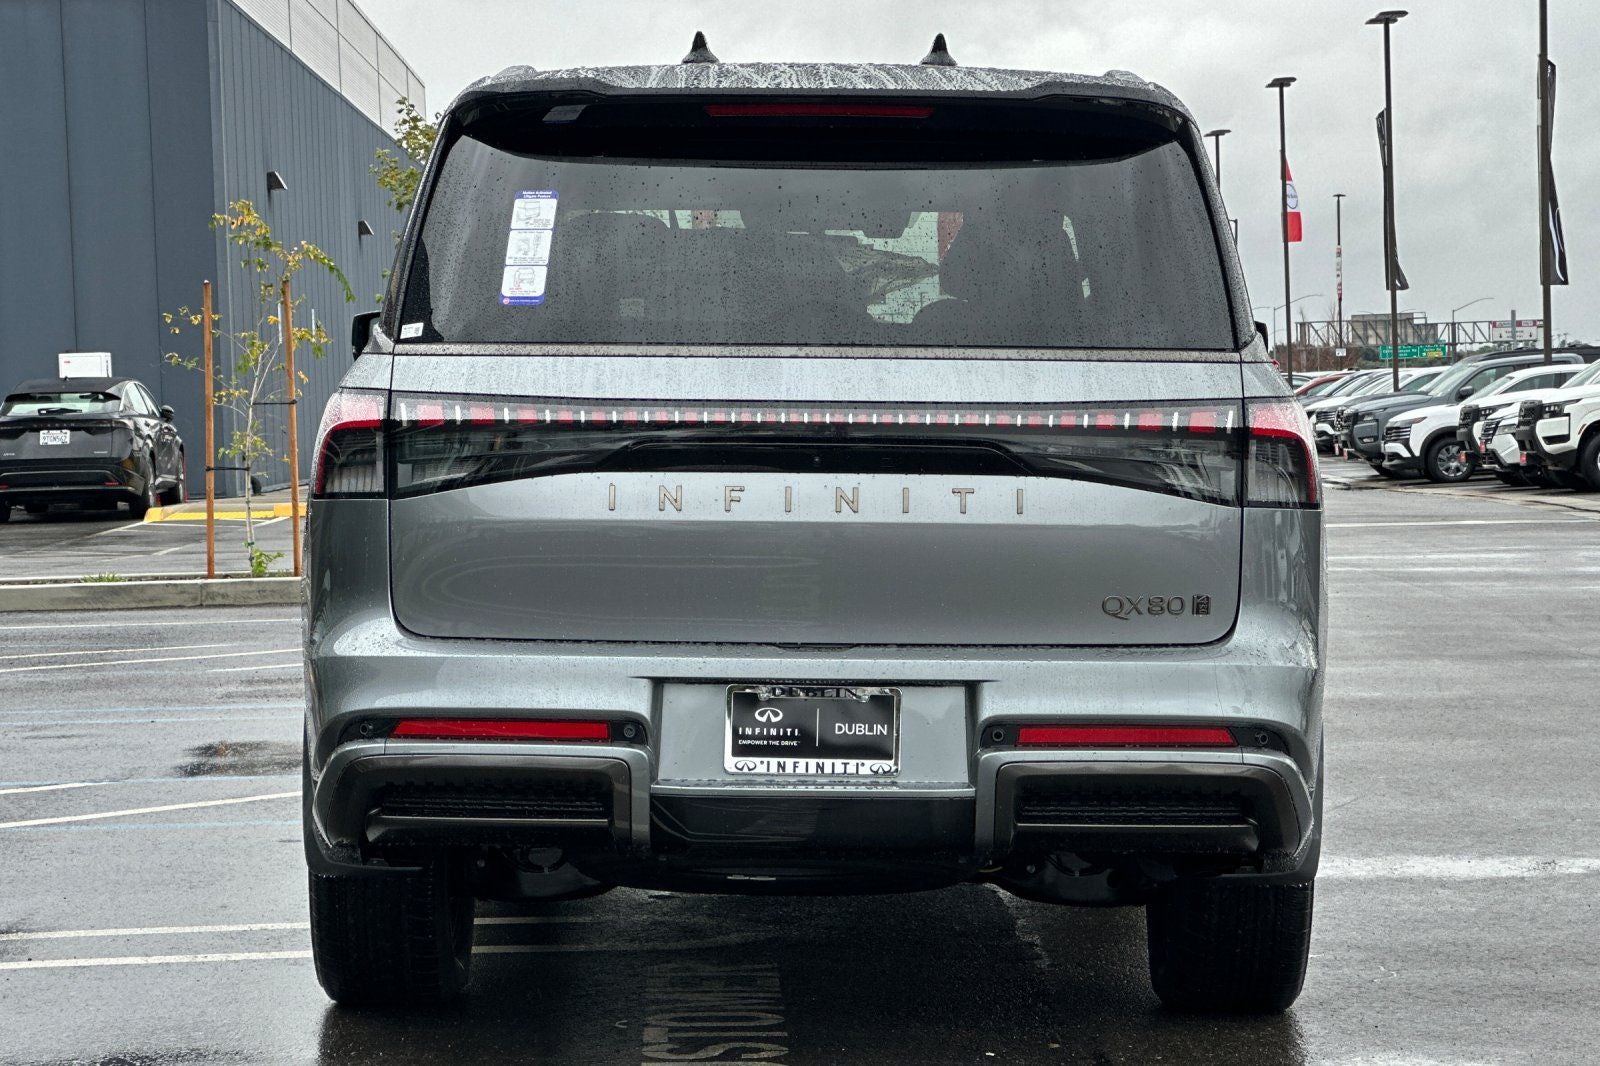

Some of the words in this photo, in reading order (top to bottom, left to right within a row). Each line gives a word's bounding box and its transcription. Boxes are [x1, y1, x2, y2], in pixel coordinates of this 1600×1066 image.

[608, 482, 1024, 515] INFINITI
[1102, 595, 1186, 620] QX80
[738, 727, 799, 737] INFINITI
[834, 722, 888, 736] DUBLIN
